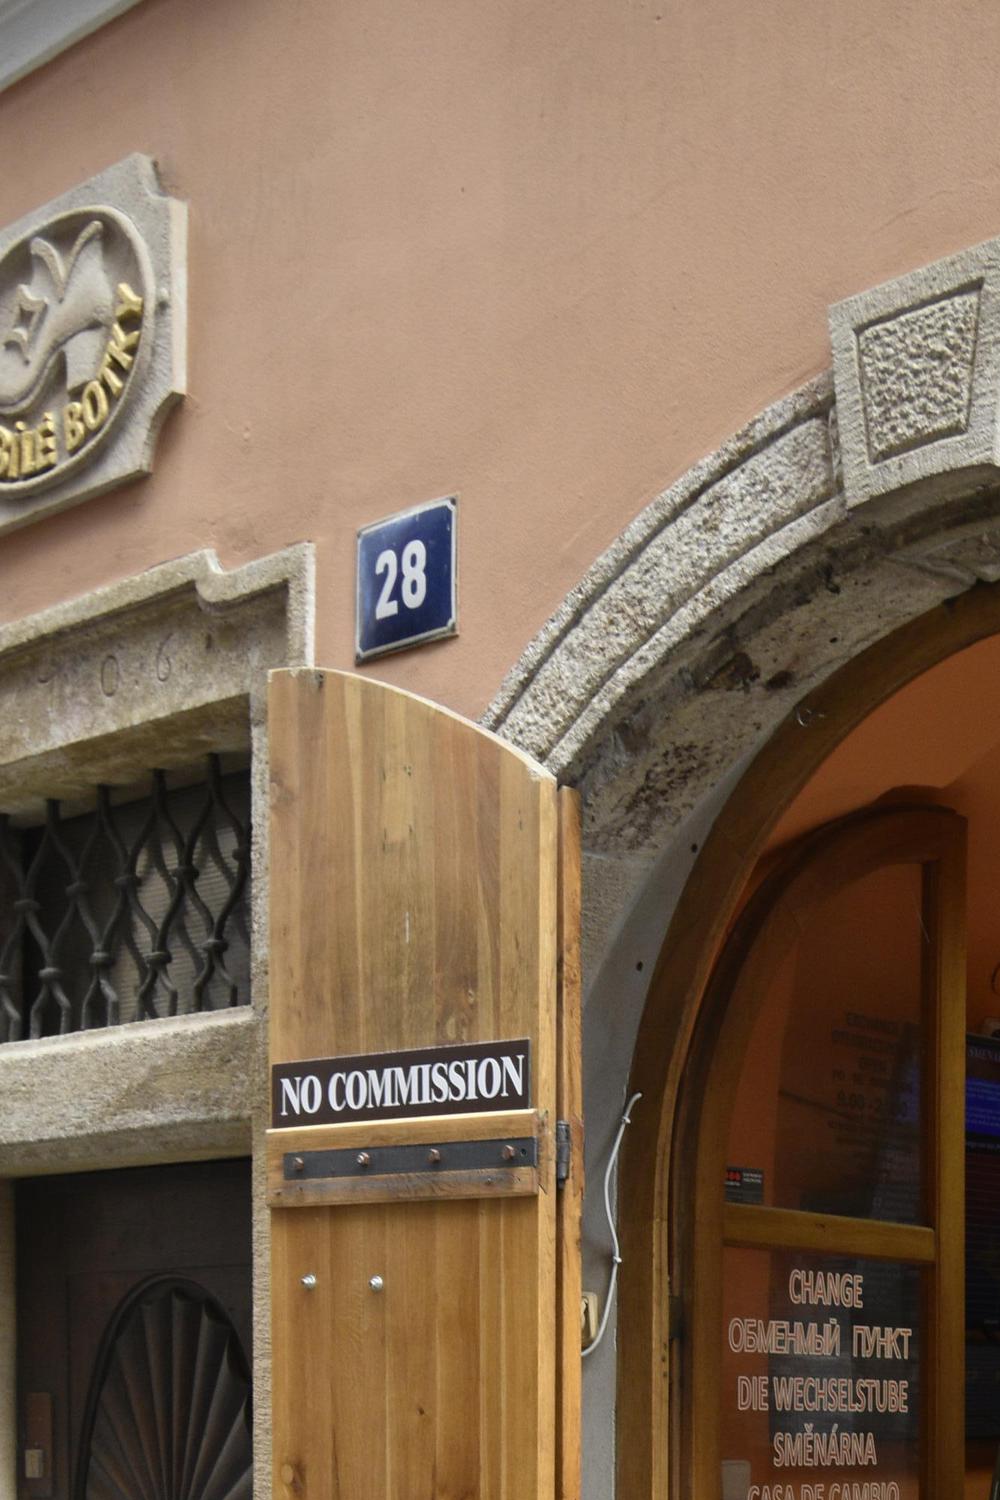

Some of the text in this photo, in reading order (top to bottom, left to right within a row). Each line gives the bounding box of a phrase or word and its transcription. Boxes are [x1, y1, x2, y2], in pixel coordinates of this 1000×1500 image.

[63, 283, 144, 451] BOTKY
[373, 538, 427, 621] 28
[280, 1054, 525, 1116] NO COMMISSION
[788, 1268, 864, 1309] CHANGE
[852, 1325, 912, 1360] ПУНКТ
[737, 1375, 909, 1413] DIE WECHSELSTUBE
[773, 1423, 878, 1467] SMĚNÁRNA
